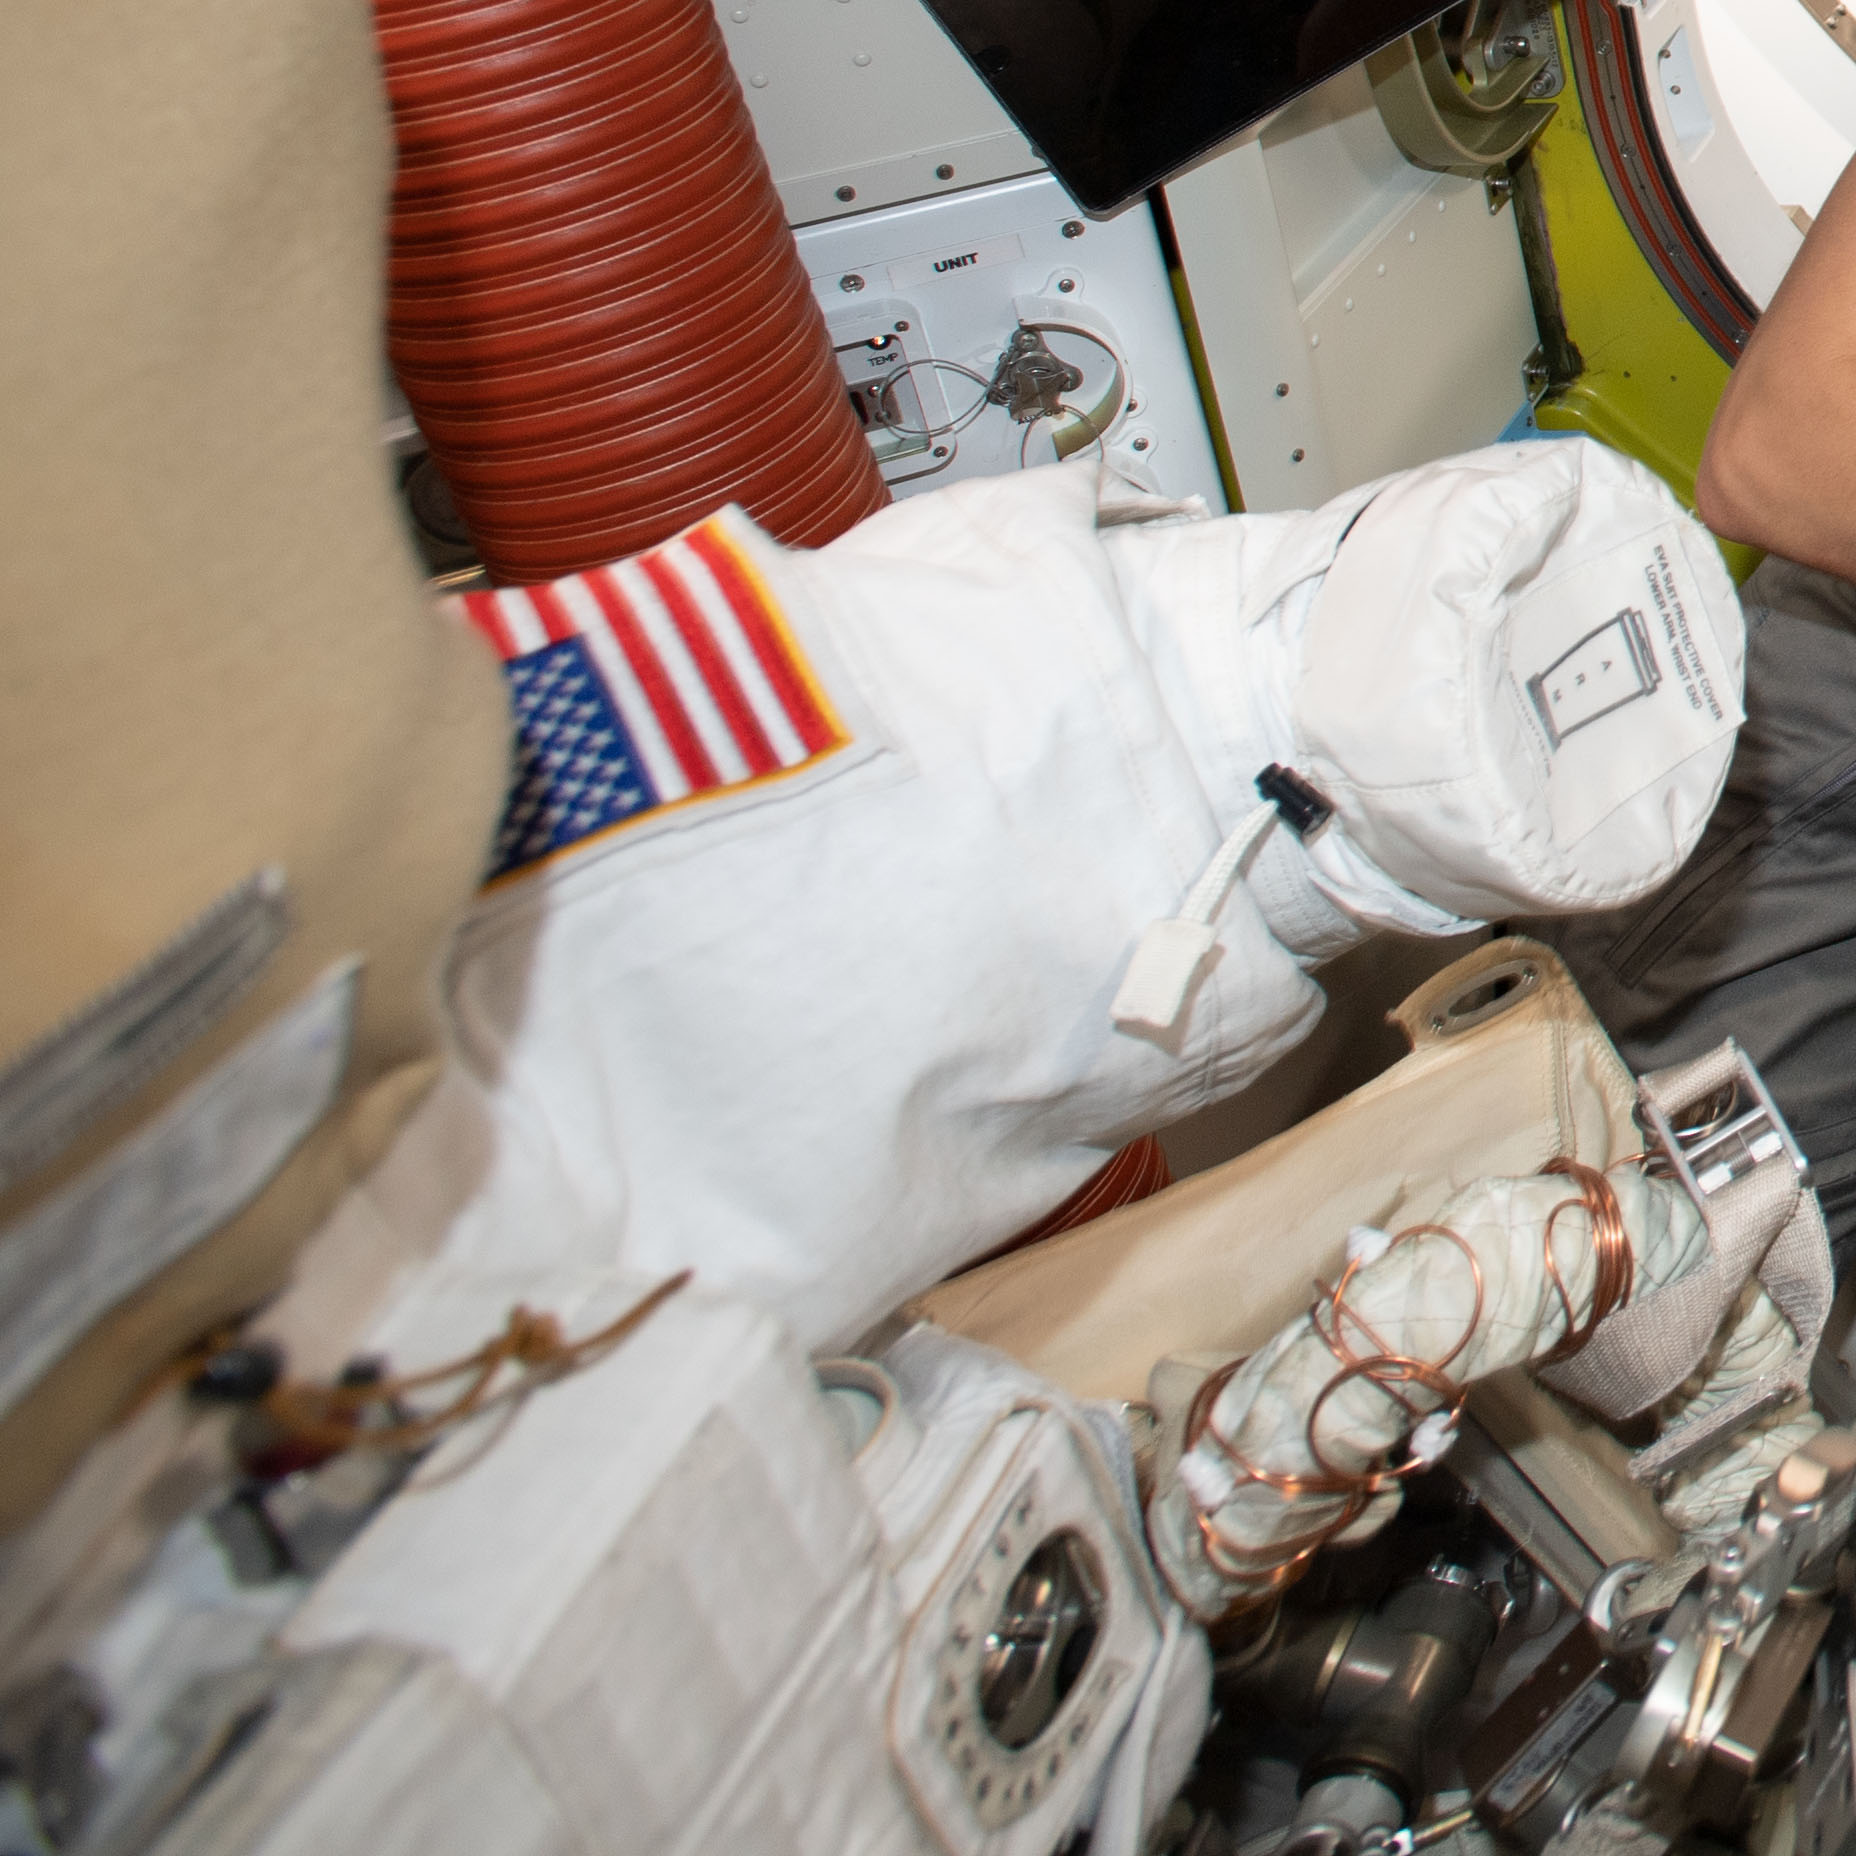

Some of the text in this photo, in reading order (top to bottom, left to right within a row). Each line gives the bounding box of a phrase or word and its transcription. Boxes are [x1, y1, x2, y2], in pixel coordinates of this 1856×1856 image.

[933, 251, 979, 274] UNIT
[867, 352, 899, 368] TEMP
[1644, 563, 1666, 611] LOWER
[1670, 643, 1691, 683] WRIST
[1685, 683, 1703, 711] END
[1653, 544, 1724, 722] EVA SUIT PROTECTIVE COVER
